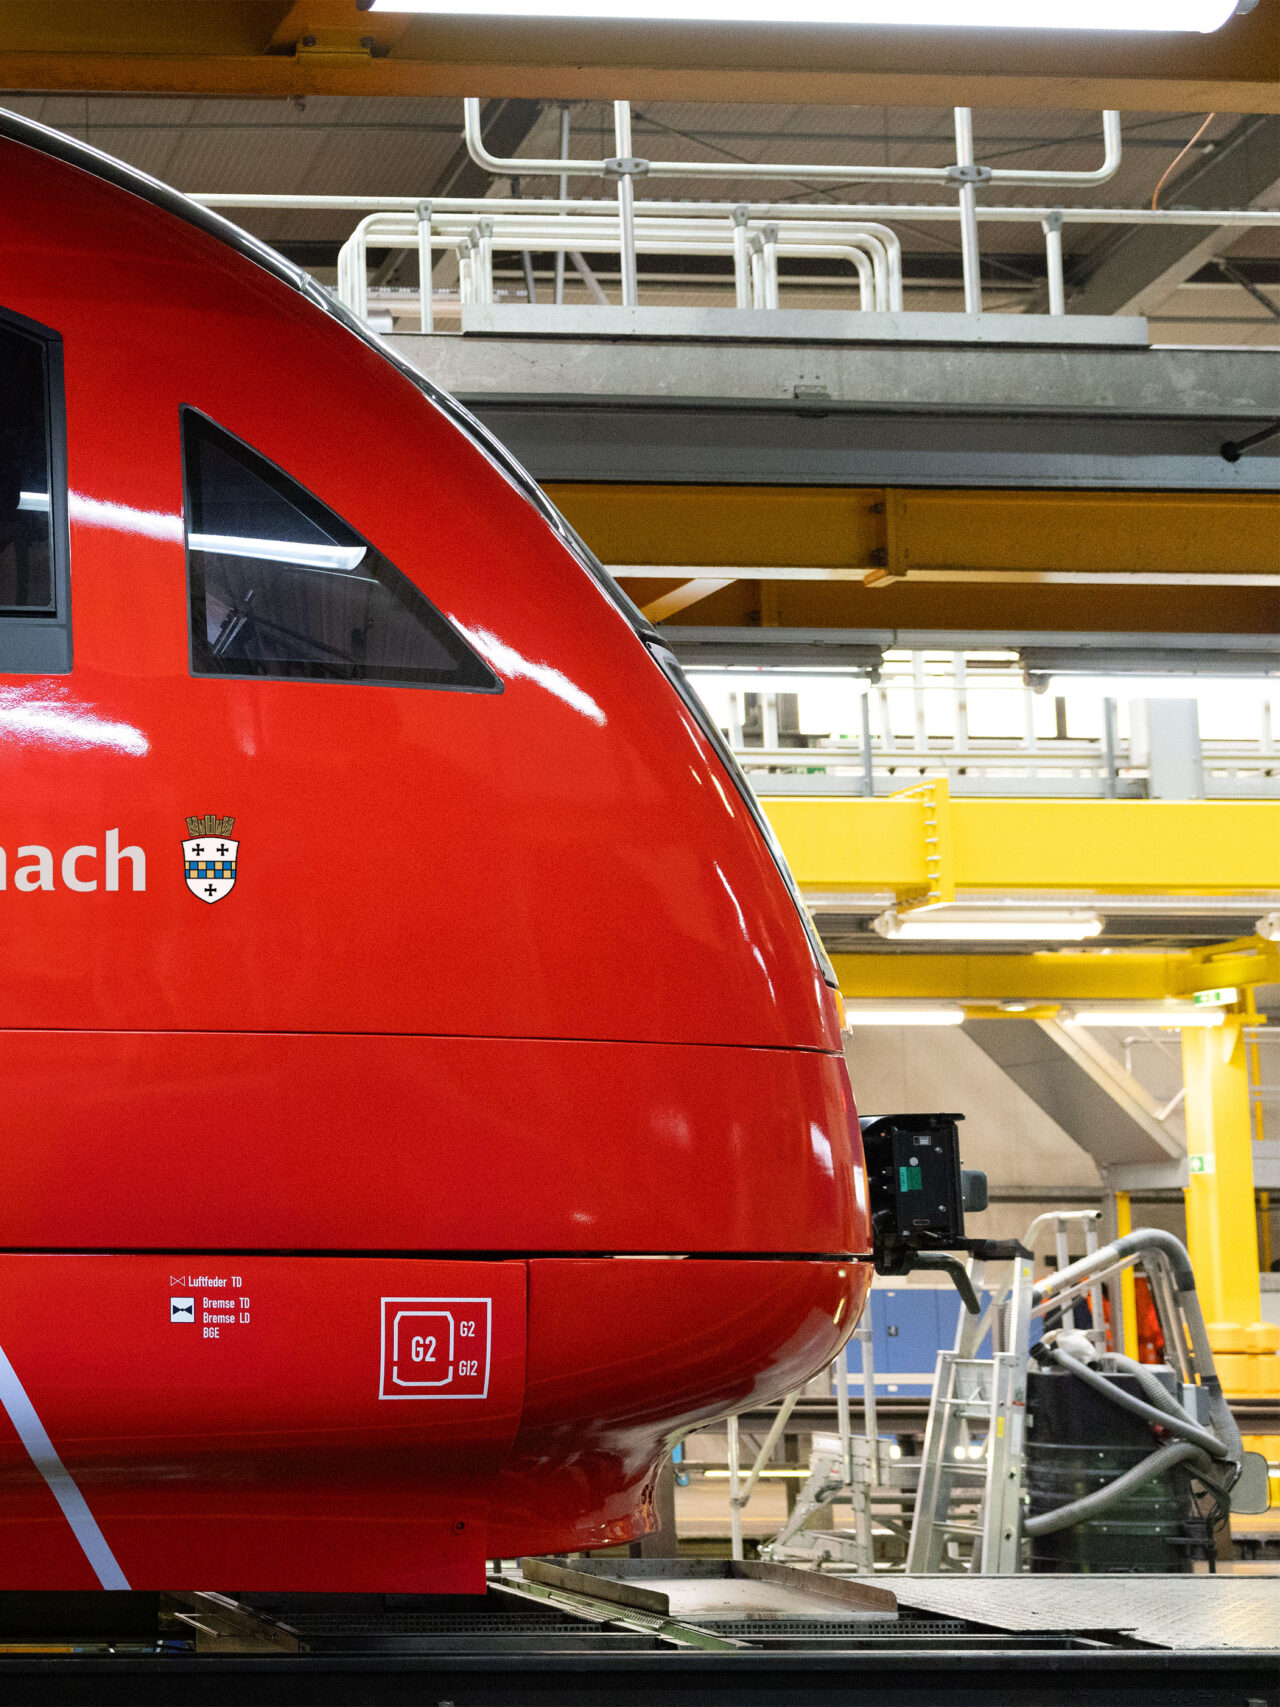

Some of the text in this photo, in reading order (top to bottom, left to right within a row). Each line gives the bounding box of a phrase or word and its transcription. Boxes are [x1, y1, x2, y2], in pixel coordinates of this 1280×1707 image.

[188, 1275, 242, 1288] Luftfeder TD
[203, 1297, 250, 1309] Bremse TD
[203, 1312, 250, 1324] Bremse LD
[203, 1327, 220, 1339] BGE
[460, 1321, 475, 1337] G2
[411, 1336, 436, 1362] G2
